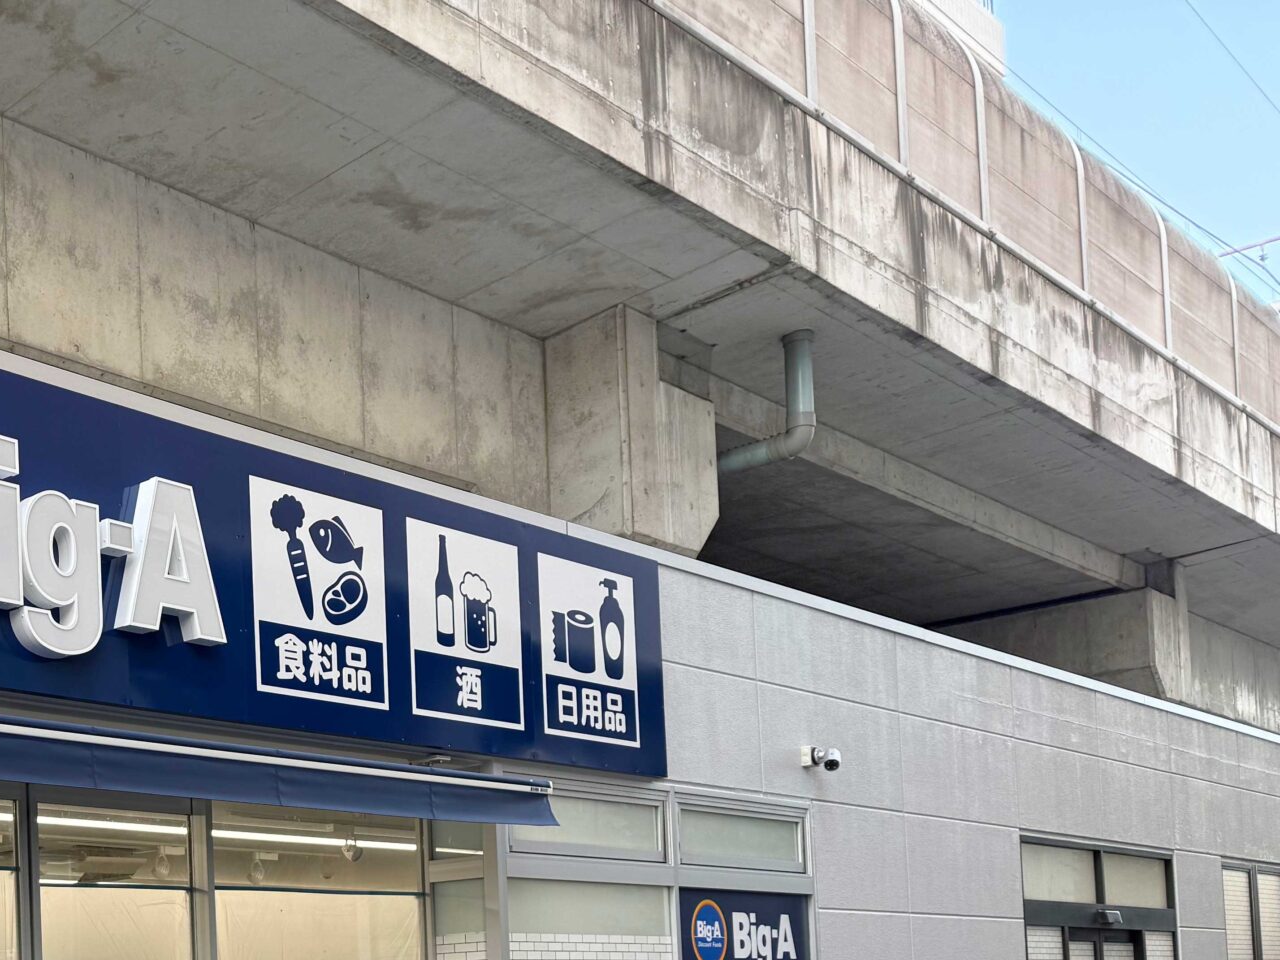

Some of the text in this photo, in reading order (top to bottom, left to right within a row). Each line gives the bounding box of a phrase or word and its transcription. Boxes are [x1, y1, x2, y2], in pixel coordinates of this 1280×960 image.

[275, 633, 371, 693] 食料品
[455, 665, 483, 711] 酒
[557, 683, 626, 734] 日用品
[696, 920, 721, 942] Big-A
